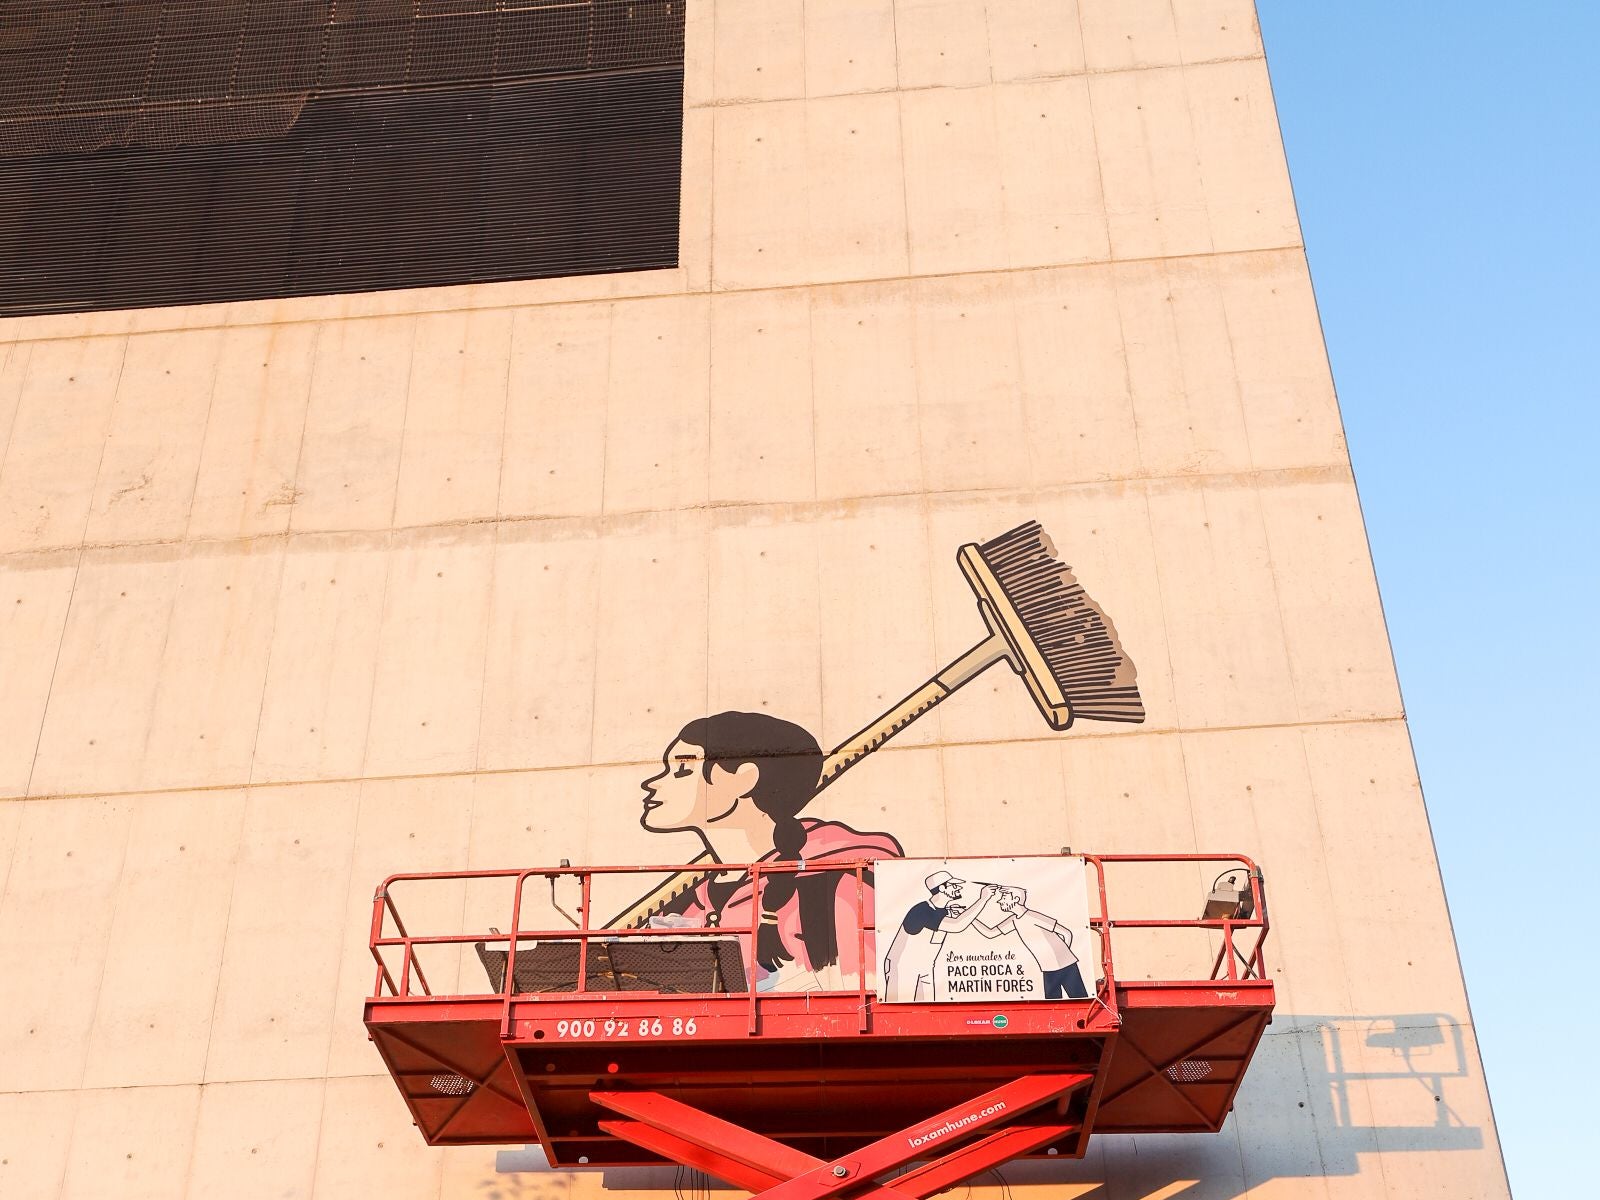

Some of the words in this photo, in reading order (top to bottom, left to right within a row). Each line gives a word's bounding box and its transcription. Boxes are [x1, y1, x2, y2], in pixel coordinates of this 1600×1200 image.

[946, 950, 963, 962] Los
[966, 950, 1002, 961] murales
[1004, 950, 1016, 960] de
[947, 965, 977, 977] PACO
[981, 964, 1013, 976] ROCA
[1016, 964, 1025, 976] &
[948, 977, 992, 992] MARTÍN
[996, 976, 1034, 992] FORÉS
[557, 1020, 595, 1038] 900
[604, 1019, 629, 1037] 92
[638, 1019, 663, 1036] 86
[672, 1018, 697, 1035] 86
[908, 1101, 1007, 1148] loxamhune.com
